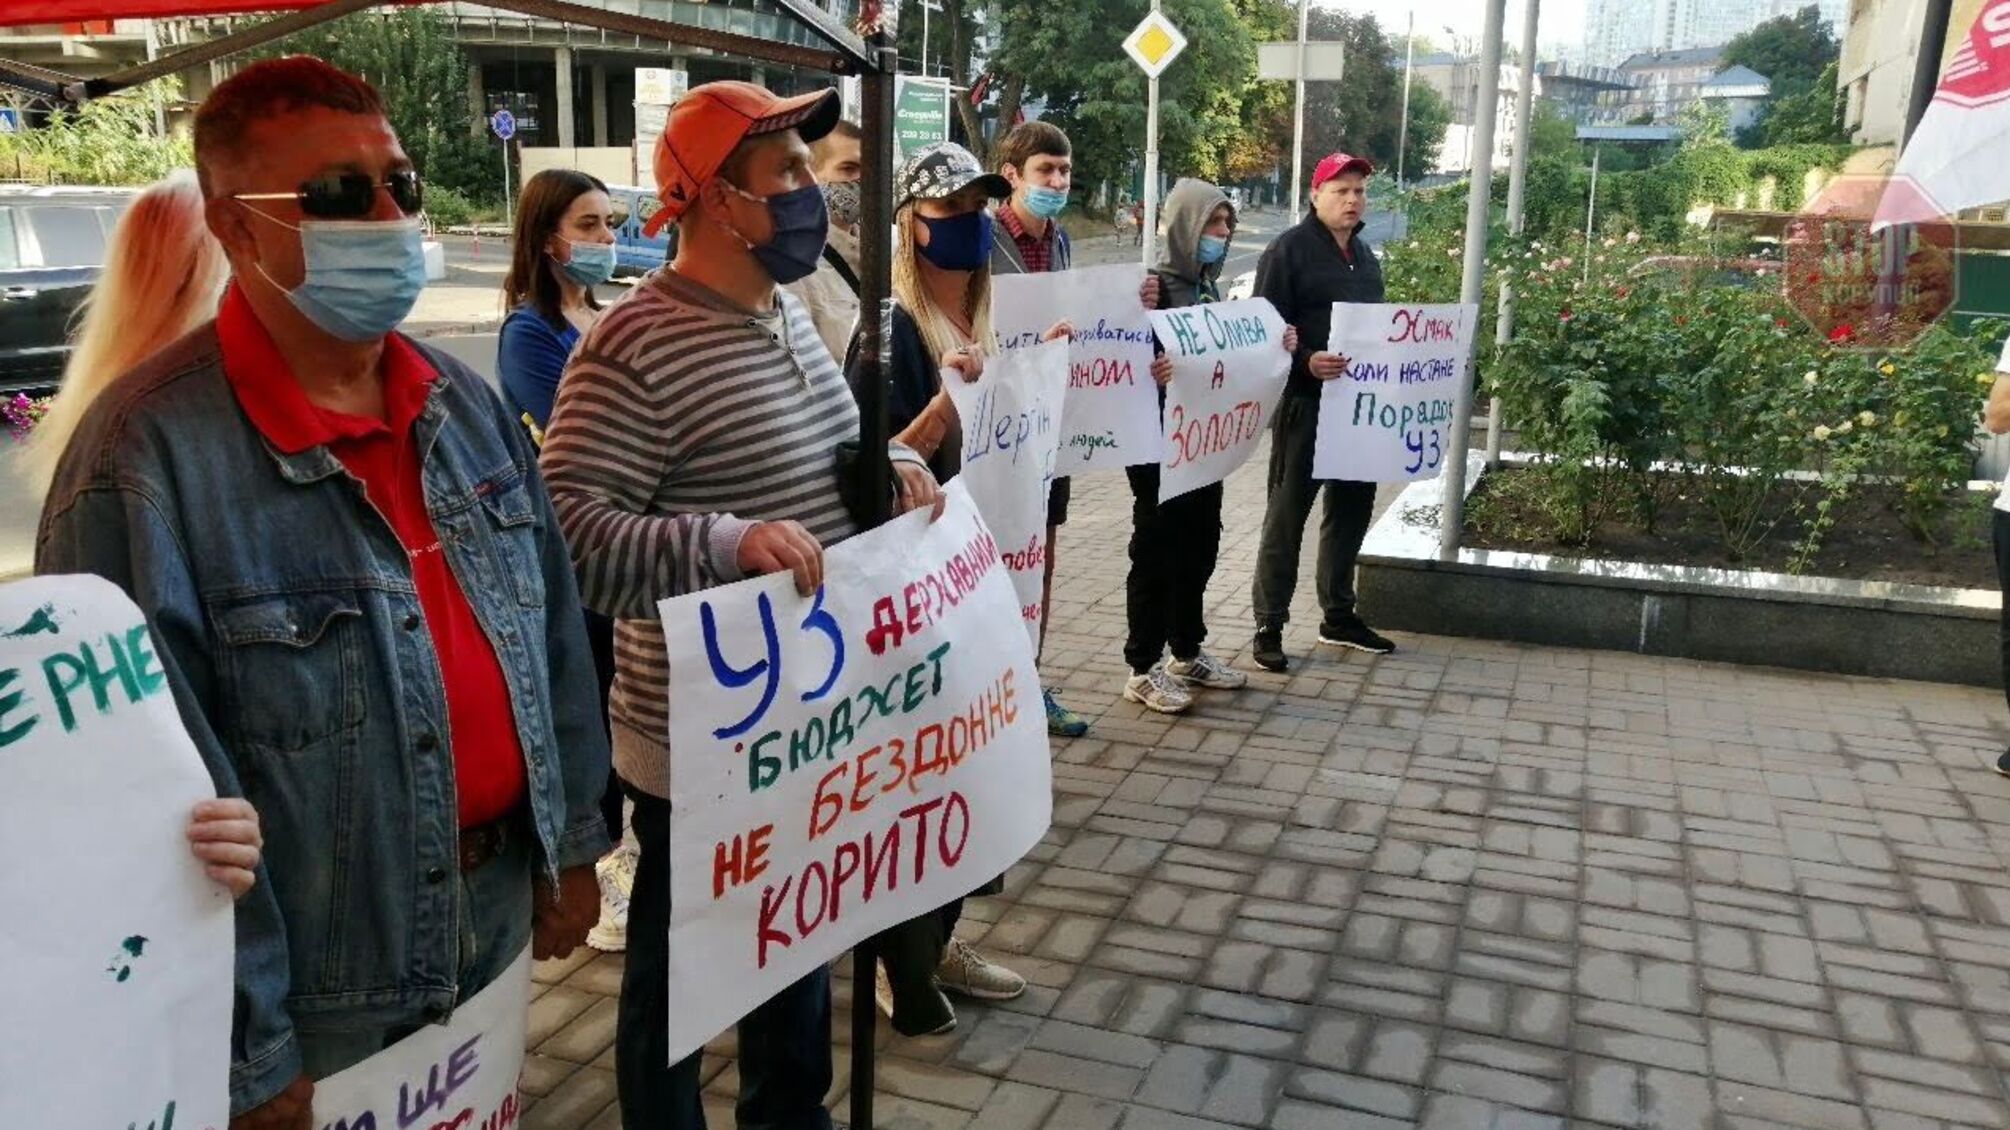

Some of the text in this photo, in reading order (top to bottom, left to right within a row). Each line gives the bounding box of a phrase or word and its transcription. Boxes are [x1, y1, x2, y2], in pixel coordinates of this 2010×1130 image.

[1165, 311, 1207, 357] НЕ
[1210, 359, 1224, 390] А
[699, 584, 846, 740] УЗ
[746, 640, 951, 793] БЮДЖЕТ
[712, 667, 1018, 900] НЕ БЕЗДОННЕ
[756, 791, 971, 969] КОРИТО
